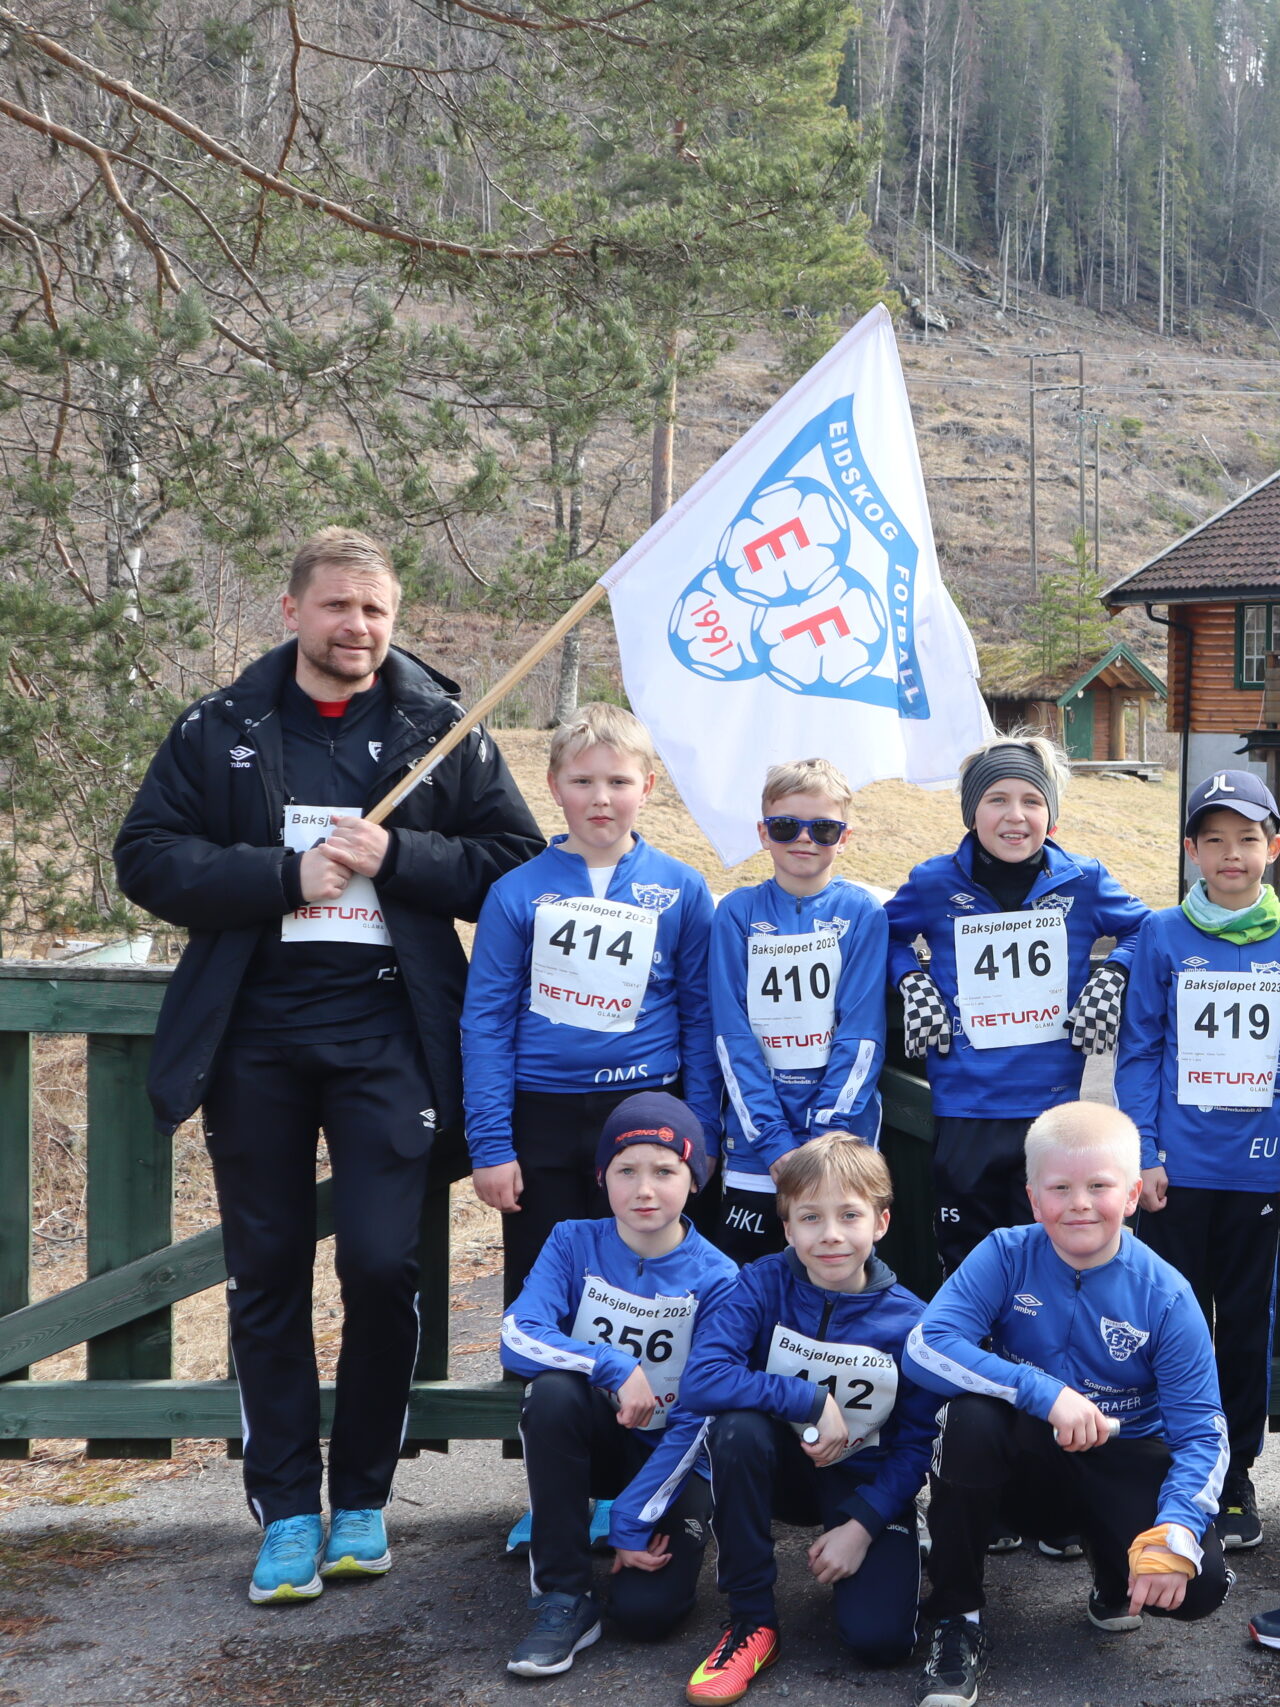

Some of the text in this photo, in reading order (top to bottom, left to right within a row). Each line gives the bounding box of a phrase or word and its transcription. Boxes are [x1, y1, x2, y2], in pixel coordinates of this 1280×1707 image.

[829, 420, 923, 703] EIDSKOG FOTBALL
[742, 517, 851, 648] E F
[690, 599, 734, 657] 1991
[294, 906, 384, 922] RETURA
[961, 916, 1062, 935] Baksjøløpet 2023
[549, 919, 633, 966] 414
[751, 936, 836, 956] Baksjøløpet 2023
[974, 940, 1051, 981] 416
[761, 962, 830, 1003] 410
[1184, 979, 1257, 993] Baksjøløpet
[539, 983, 621, 1012] RETURA
[971, 1008, 1053, 1028] RETURA
[1194, 1002, 1270, 1040] 419
[1189, 1071, 1269, 1085] RETURA
[1249, 1137, 1278, 1159] EU
[725, 1205, 765, 1234] HKL
[941, 1207, 961, 1223] FS
[587, 1286, 660, 1318] Baksjøløpet
[1013, 1304, 1038, 1317] umbro
[588, 1316, 674, 1363] 356
[779, 1337, 893, 1369] Baksjøløpet 2023
